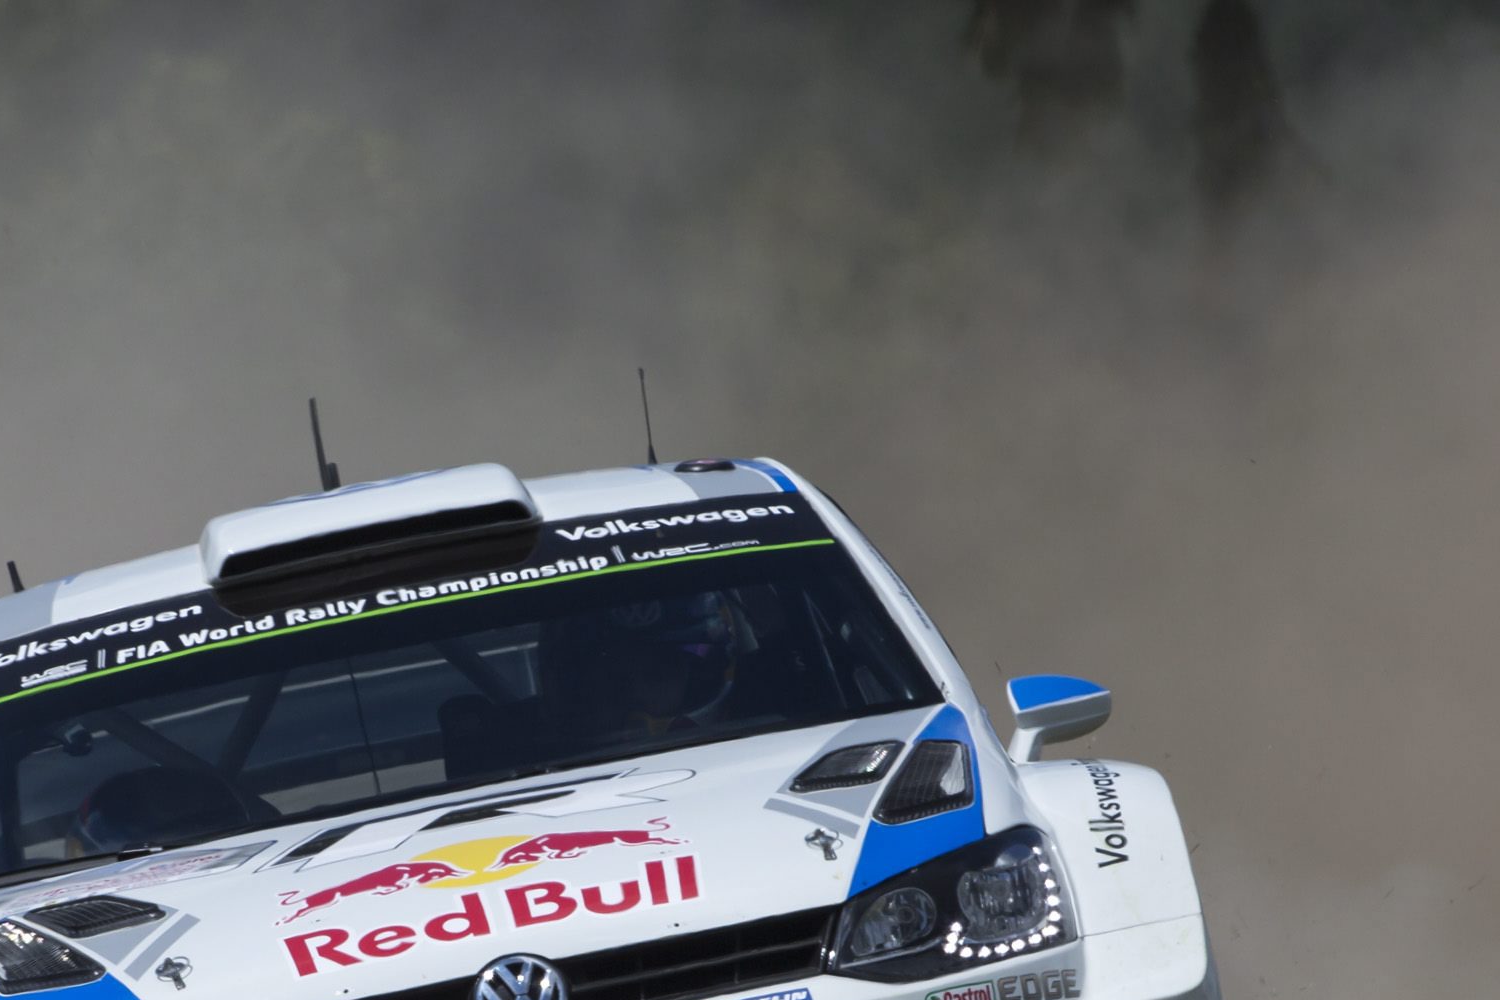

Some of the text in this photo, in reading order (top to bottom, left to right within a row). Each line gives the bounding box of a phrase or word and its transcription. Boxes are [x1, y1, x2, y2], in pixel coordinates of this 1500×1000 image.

[555, 504, 795, 542] Volkswagen
[116, 555, 609, 665] FIA World Rally Championship
[284, 855, 699, 977] Red Bull
